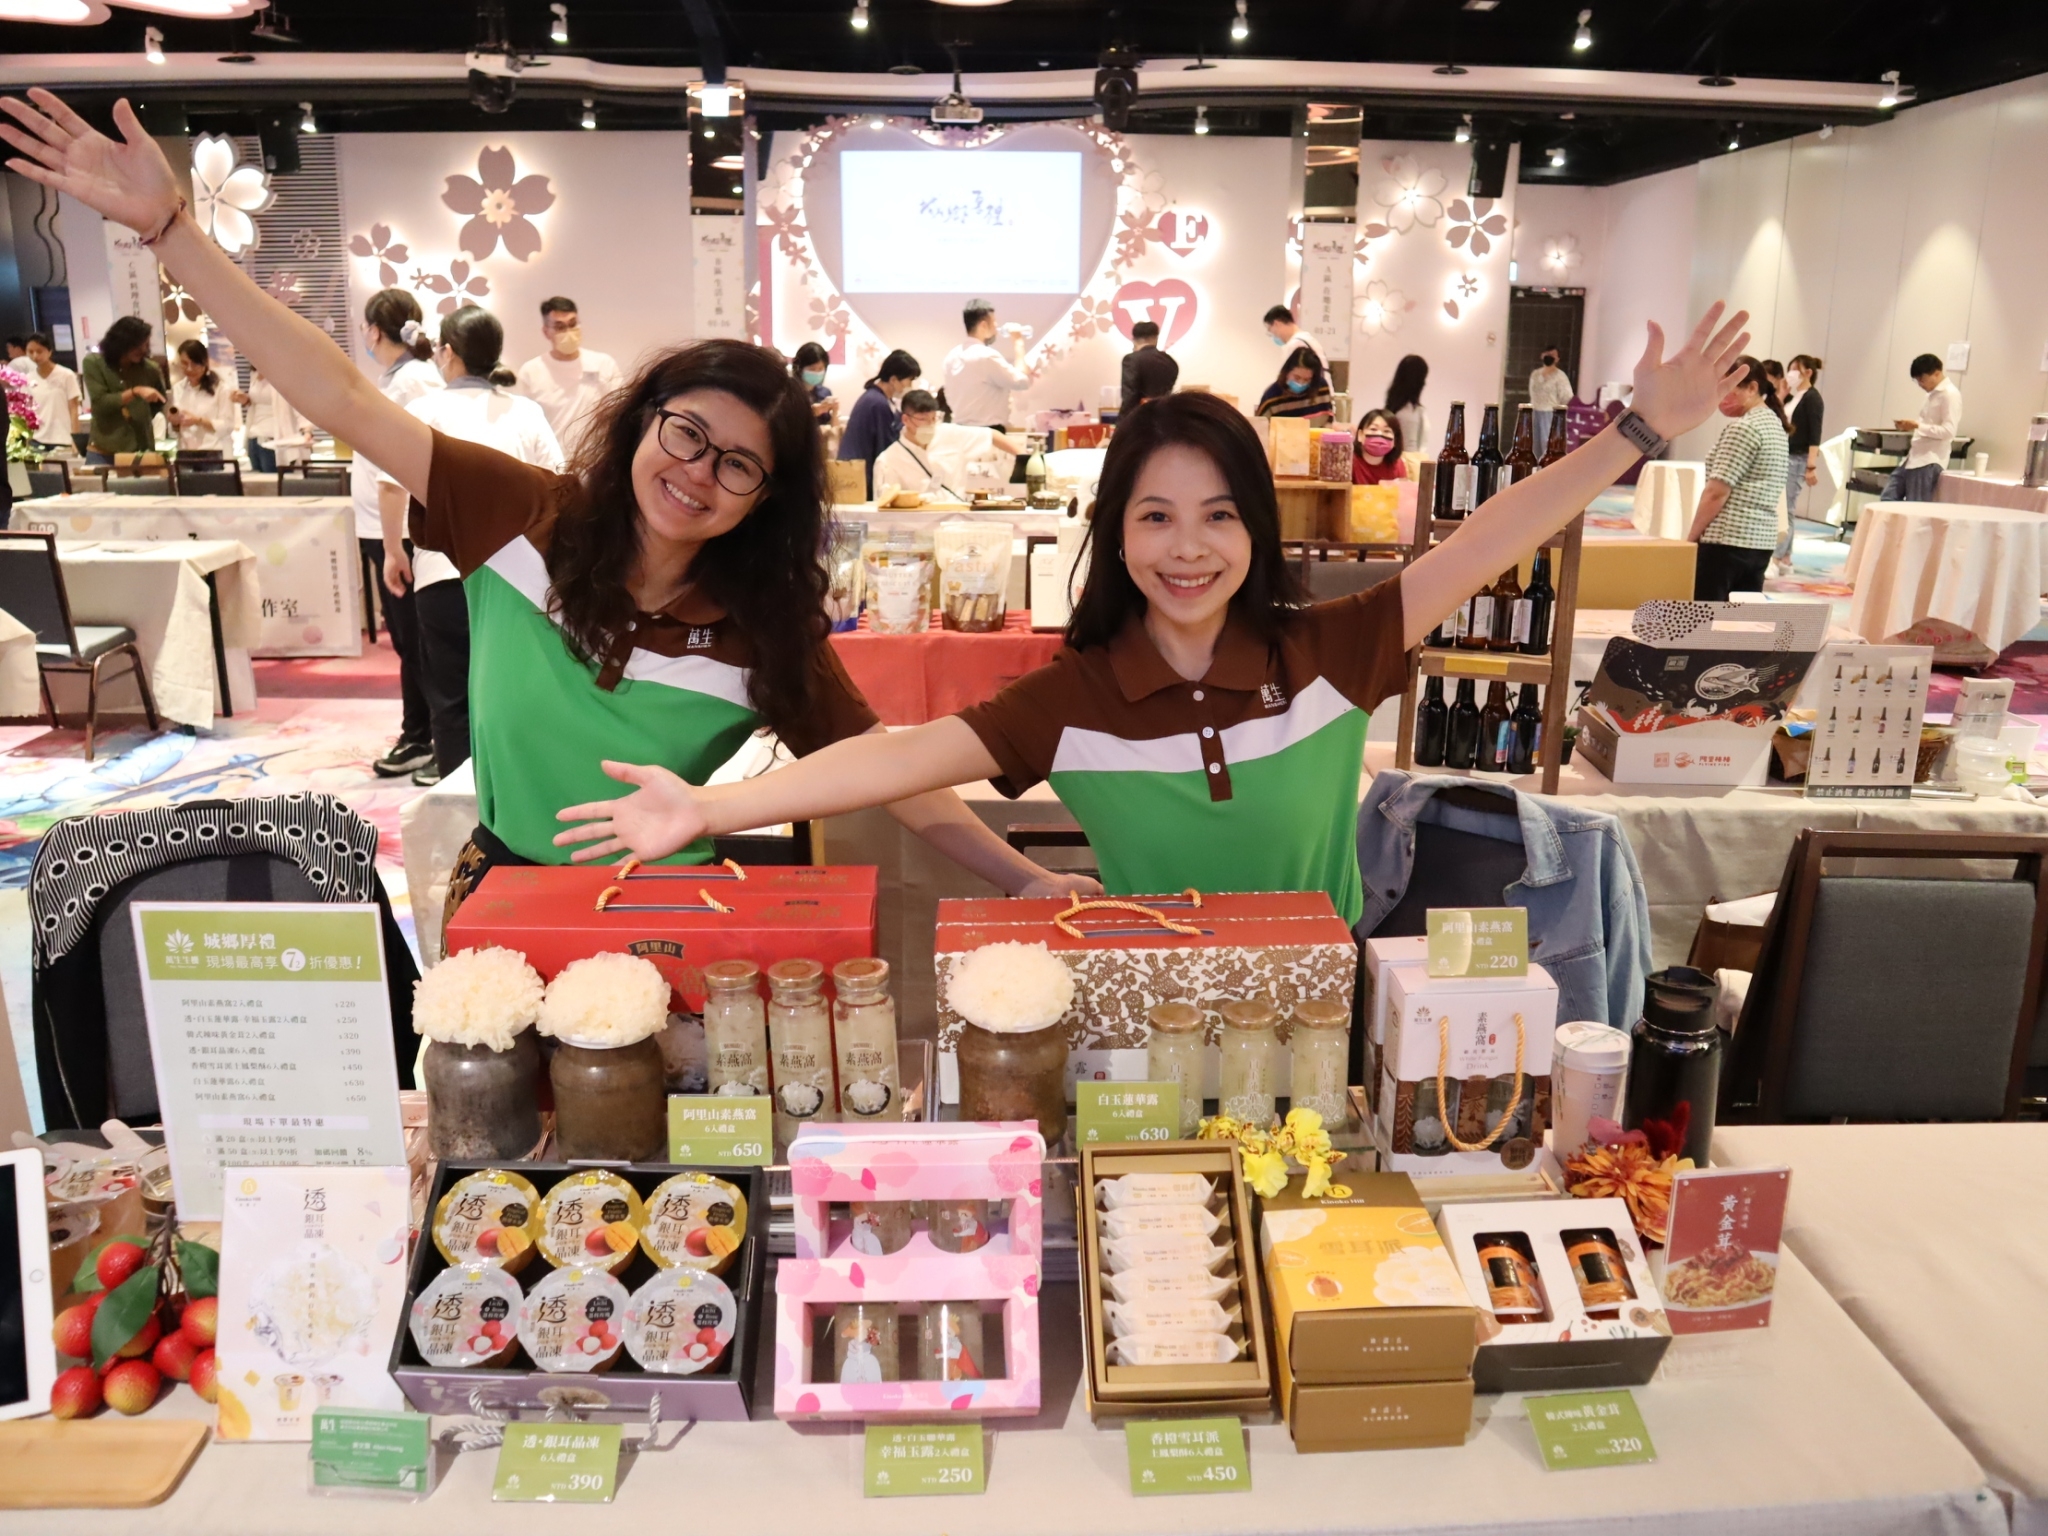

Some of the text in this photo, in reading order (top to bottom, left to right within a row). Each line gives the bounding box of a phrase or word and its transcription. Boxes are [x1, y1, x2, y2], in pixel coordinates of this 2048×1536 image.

[688, 628, 713, 645] 萬生
[1260, 682, 1286, 704] 萬生
[203, 933, 276, 950] 城鄉厚禮
[636, 942, 677, 954] 阿里山
[205, 955, 279, 970] 現場最高享
[1490, 955, 1518, 969] 220
[1475, 1012, 1488, 1046] 素燕窩
[716, 1053, 752, 1068] 素燕窩
[780, 1054, 815, 1068] 素燕窩
[846, 1052, 882, 1067] 素燕窩
[1466, 1062, 1489, 1070] Drink
[1098, 1094, 1159, 1106] 白玉蓮華露
[683, 1108, 757, 1121] 阿里山素燕窩
[1140, 1127, 1169, 1141] 630
[733, 1143, 762, 1157] 650
[303, 1187, 327, 1211] 透
[455, 1193, 487, 1220] 透
[555, 1197, 584, 1225] 透
[660, 1193, 691, 1221] 透
[305, 1214, 324, 1224] 銀耳
[1715, 1195, 1738, 1249] 黃金茸
[452, 1221, 477, 1234] 銀耳
[556, 1228, 580, 1240] 銀耳
[658, 1221, 683, 1235] 銀耳
[1319, 1239, 1406, 1255] 雪耳派
[431, 1292, 464, 1321] 透
[537, 1294, 567, 1323] 透
[645, 1299, 676, 1328] 透
[431, 1322, 457, 1336] 銀耳
[537, 1327, 564, 1339] 銀耳
[645, 1330, 671, 1343] 銀耳
[1152, 1431, 1219, 1446] 香橙雪耳派
[1609, 1437, 1642, 1453] 320
[938, 1468, 973, 1484] 250
[1203, 1466, 1237, 1481] 450
[568, 1475, 603, 1490] 390
